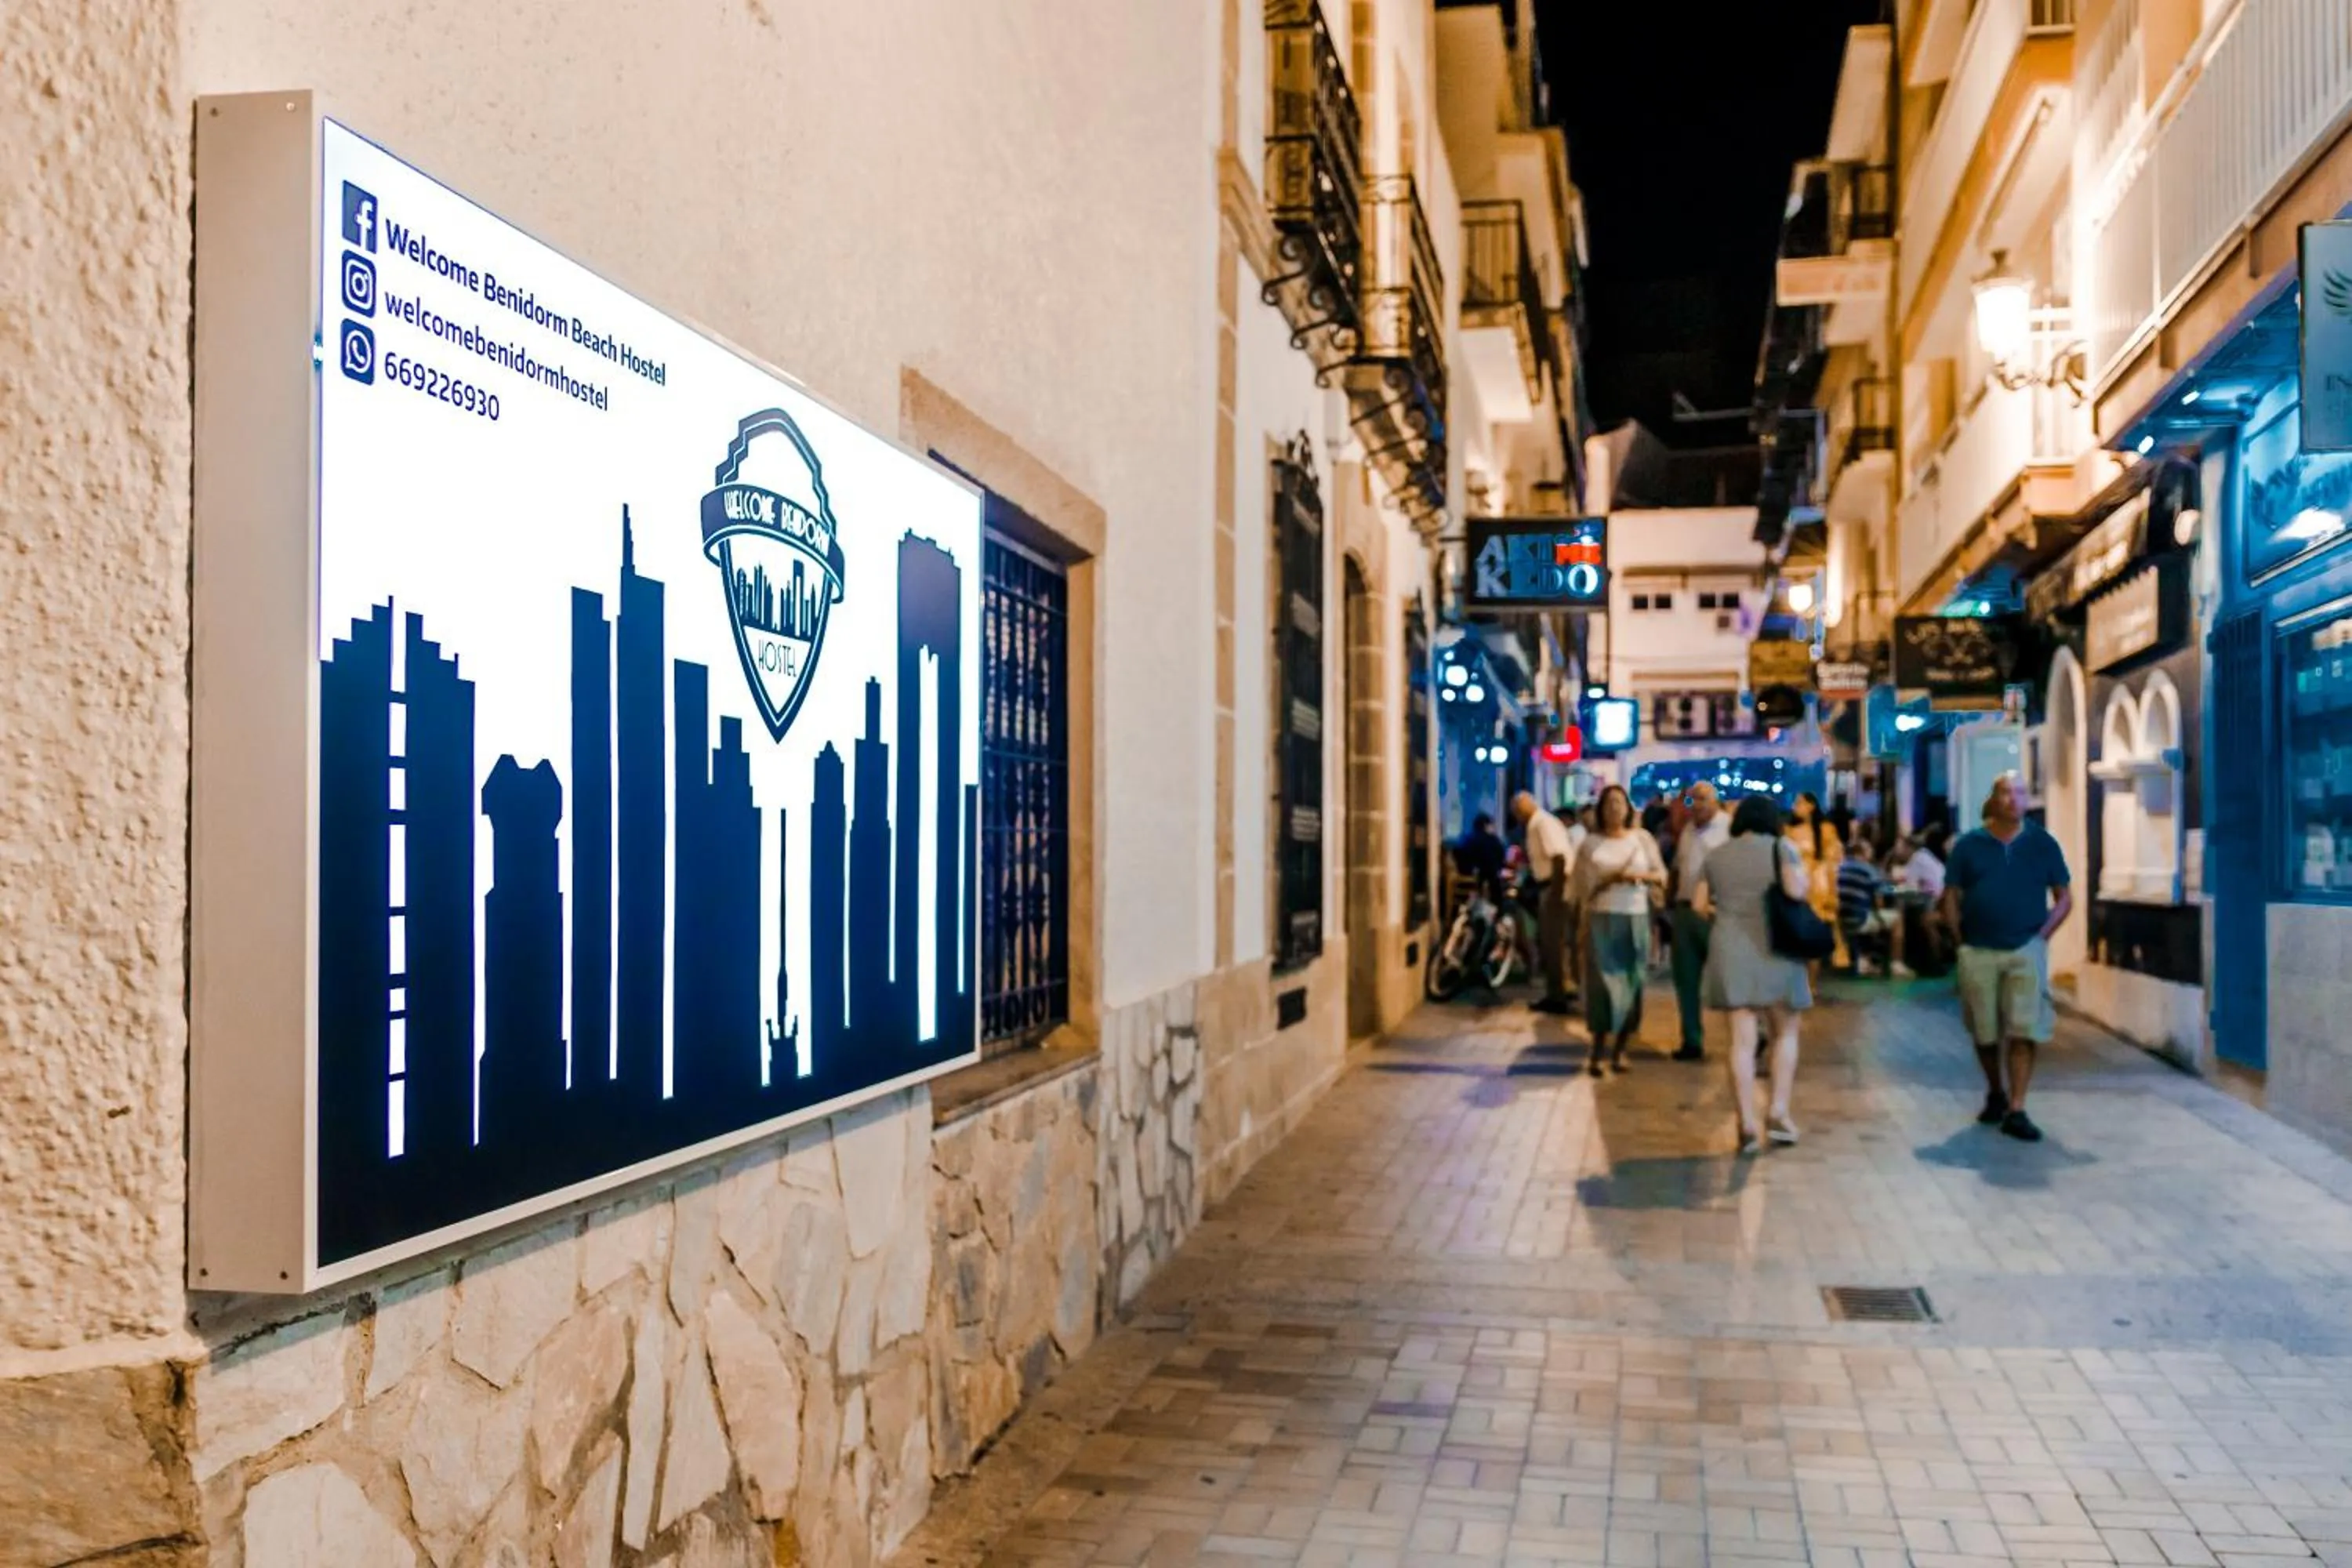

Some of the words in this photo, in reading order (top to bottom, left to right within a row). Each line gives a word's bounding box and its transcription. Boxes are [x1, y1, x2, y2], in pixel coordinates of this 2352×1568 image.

[385, 218, 479, 292] Welcome
[484, 273, 568, 337] Benidorm
[572, 318, 617, 363] Beach
[620, 343, 666, 387] Hostel
[384, 292, 608, 412] welcomebenidormhostel
[384, 351, 500, 421] 669226930
[724, 489, 775, 526] WELCOME
[758, 639, 797, 677] HOSTEL
